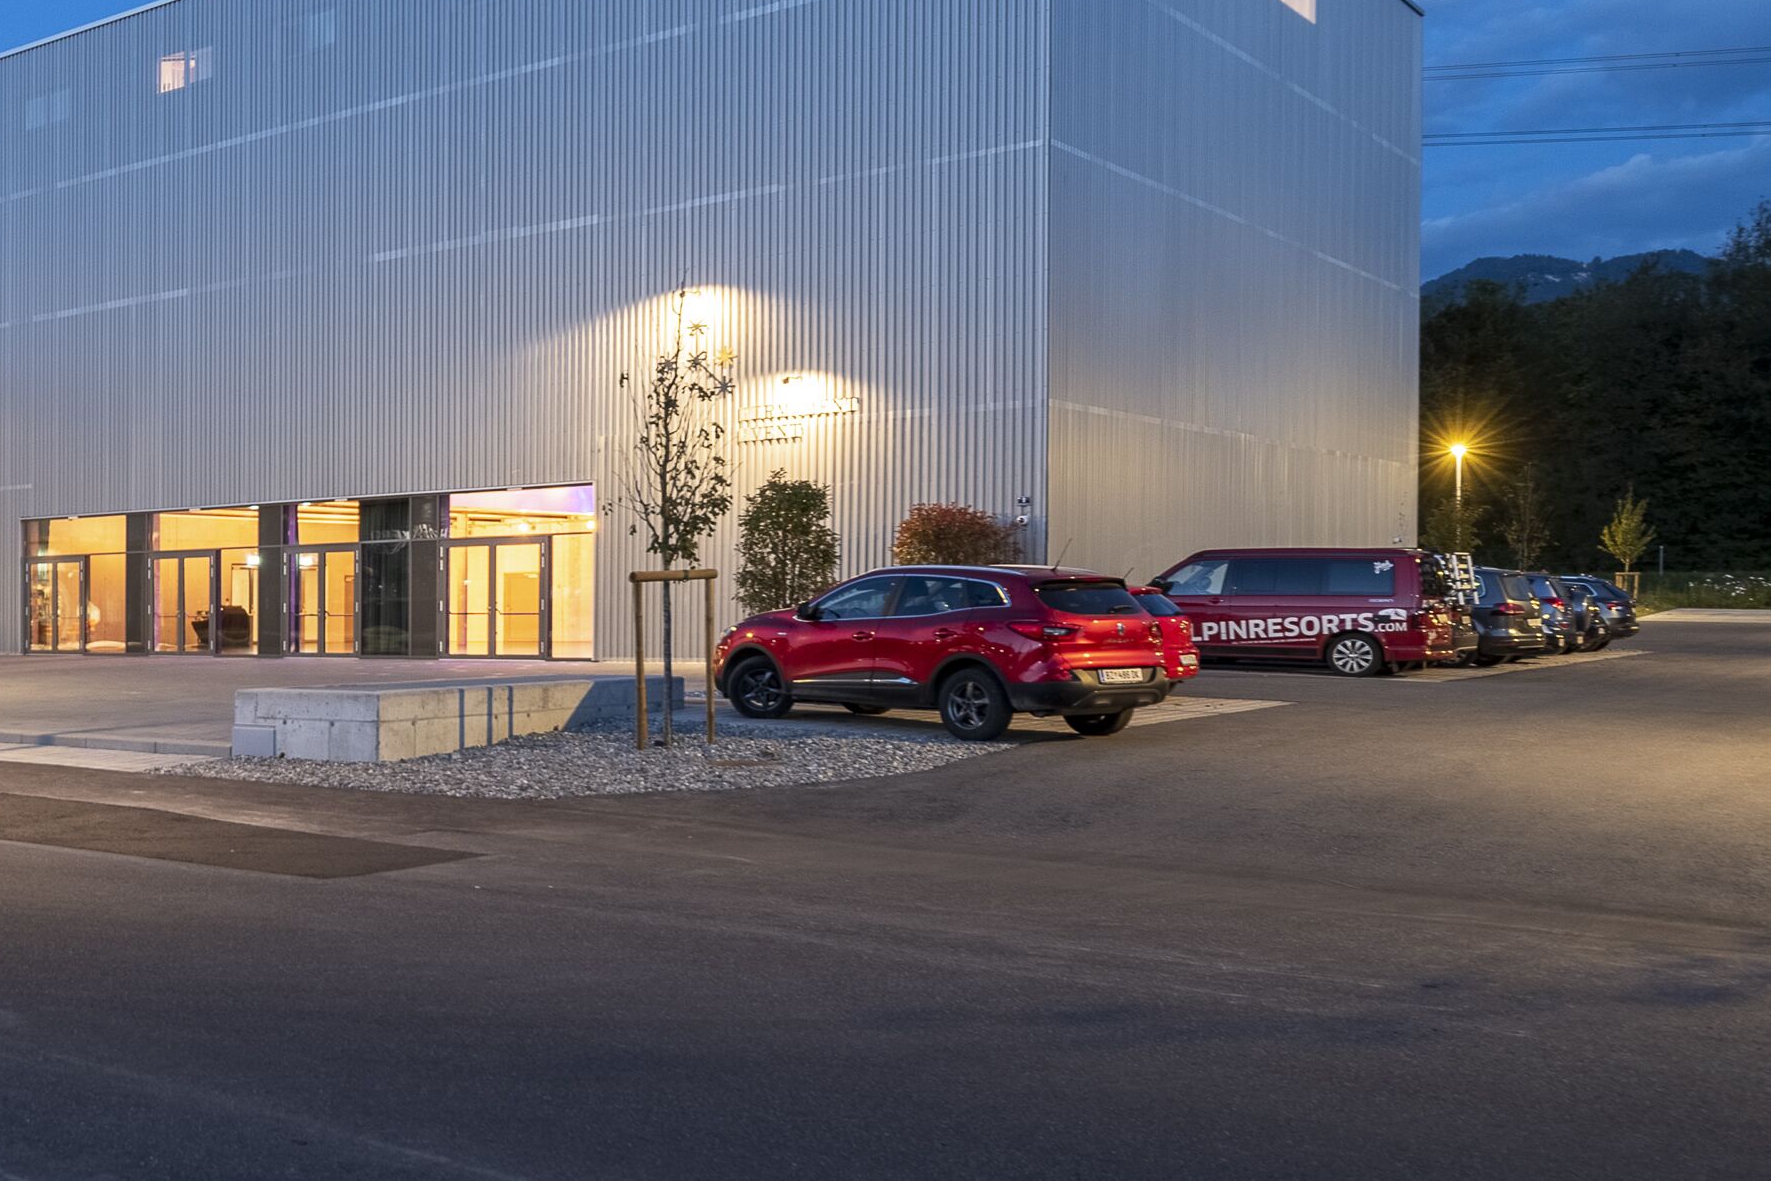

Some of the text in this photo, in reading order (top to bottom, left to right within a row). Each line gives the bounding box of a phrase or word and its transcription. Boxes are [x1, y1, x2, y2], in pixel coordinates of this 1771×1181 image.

[738, 396, 860, 422] FIRMENT
[738, 422, 803, 444] EVENT
[1190, 611, 1408, 642] LPINRESORTS.COM
